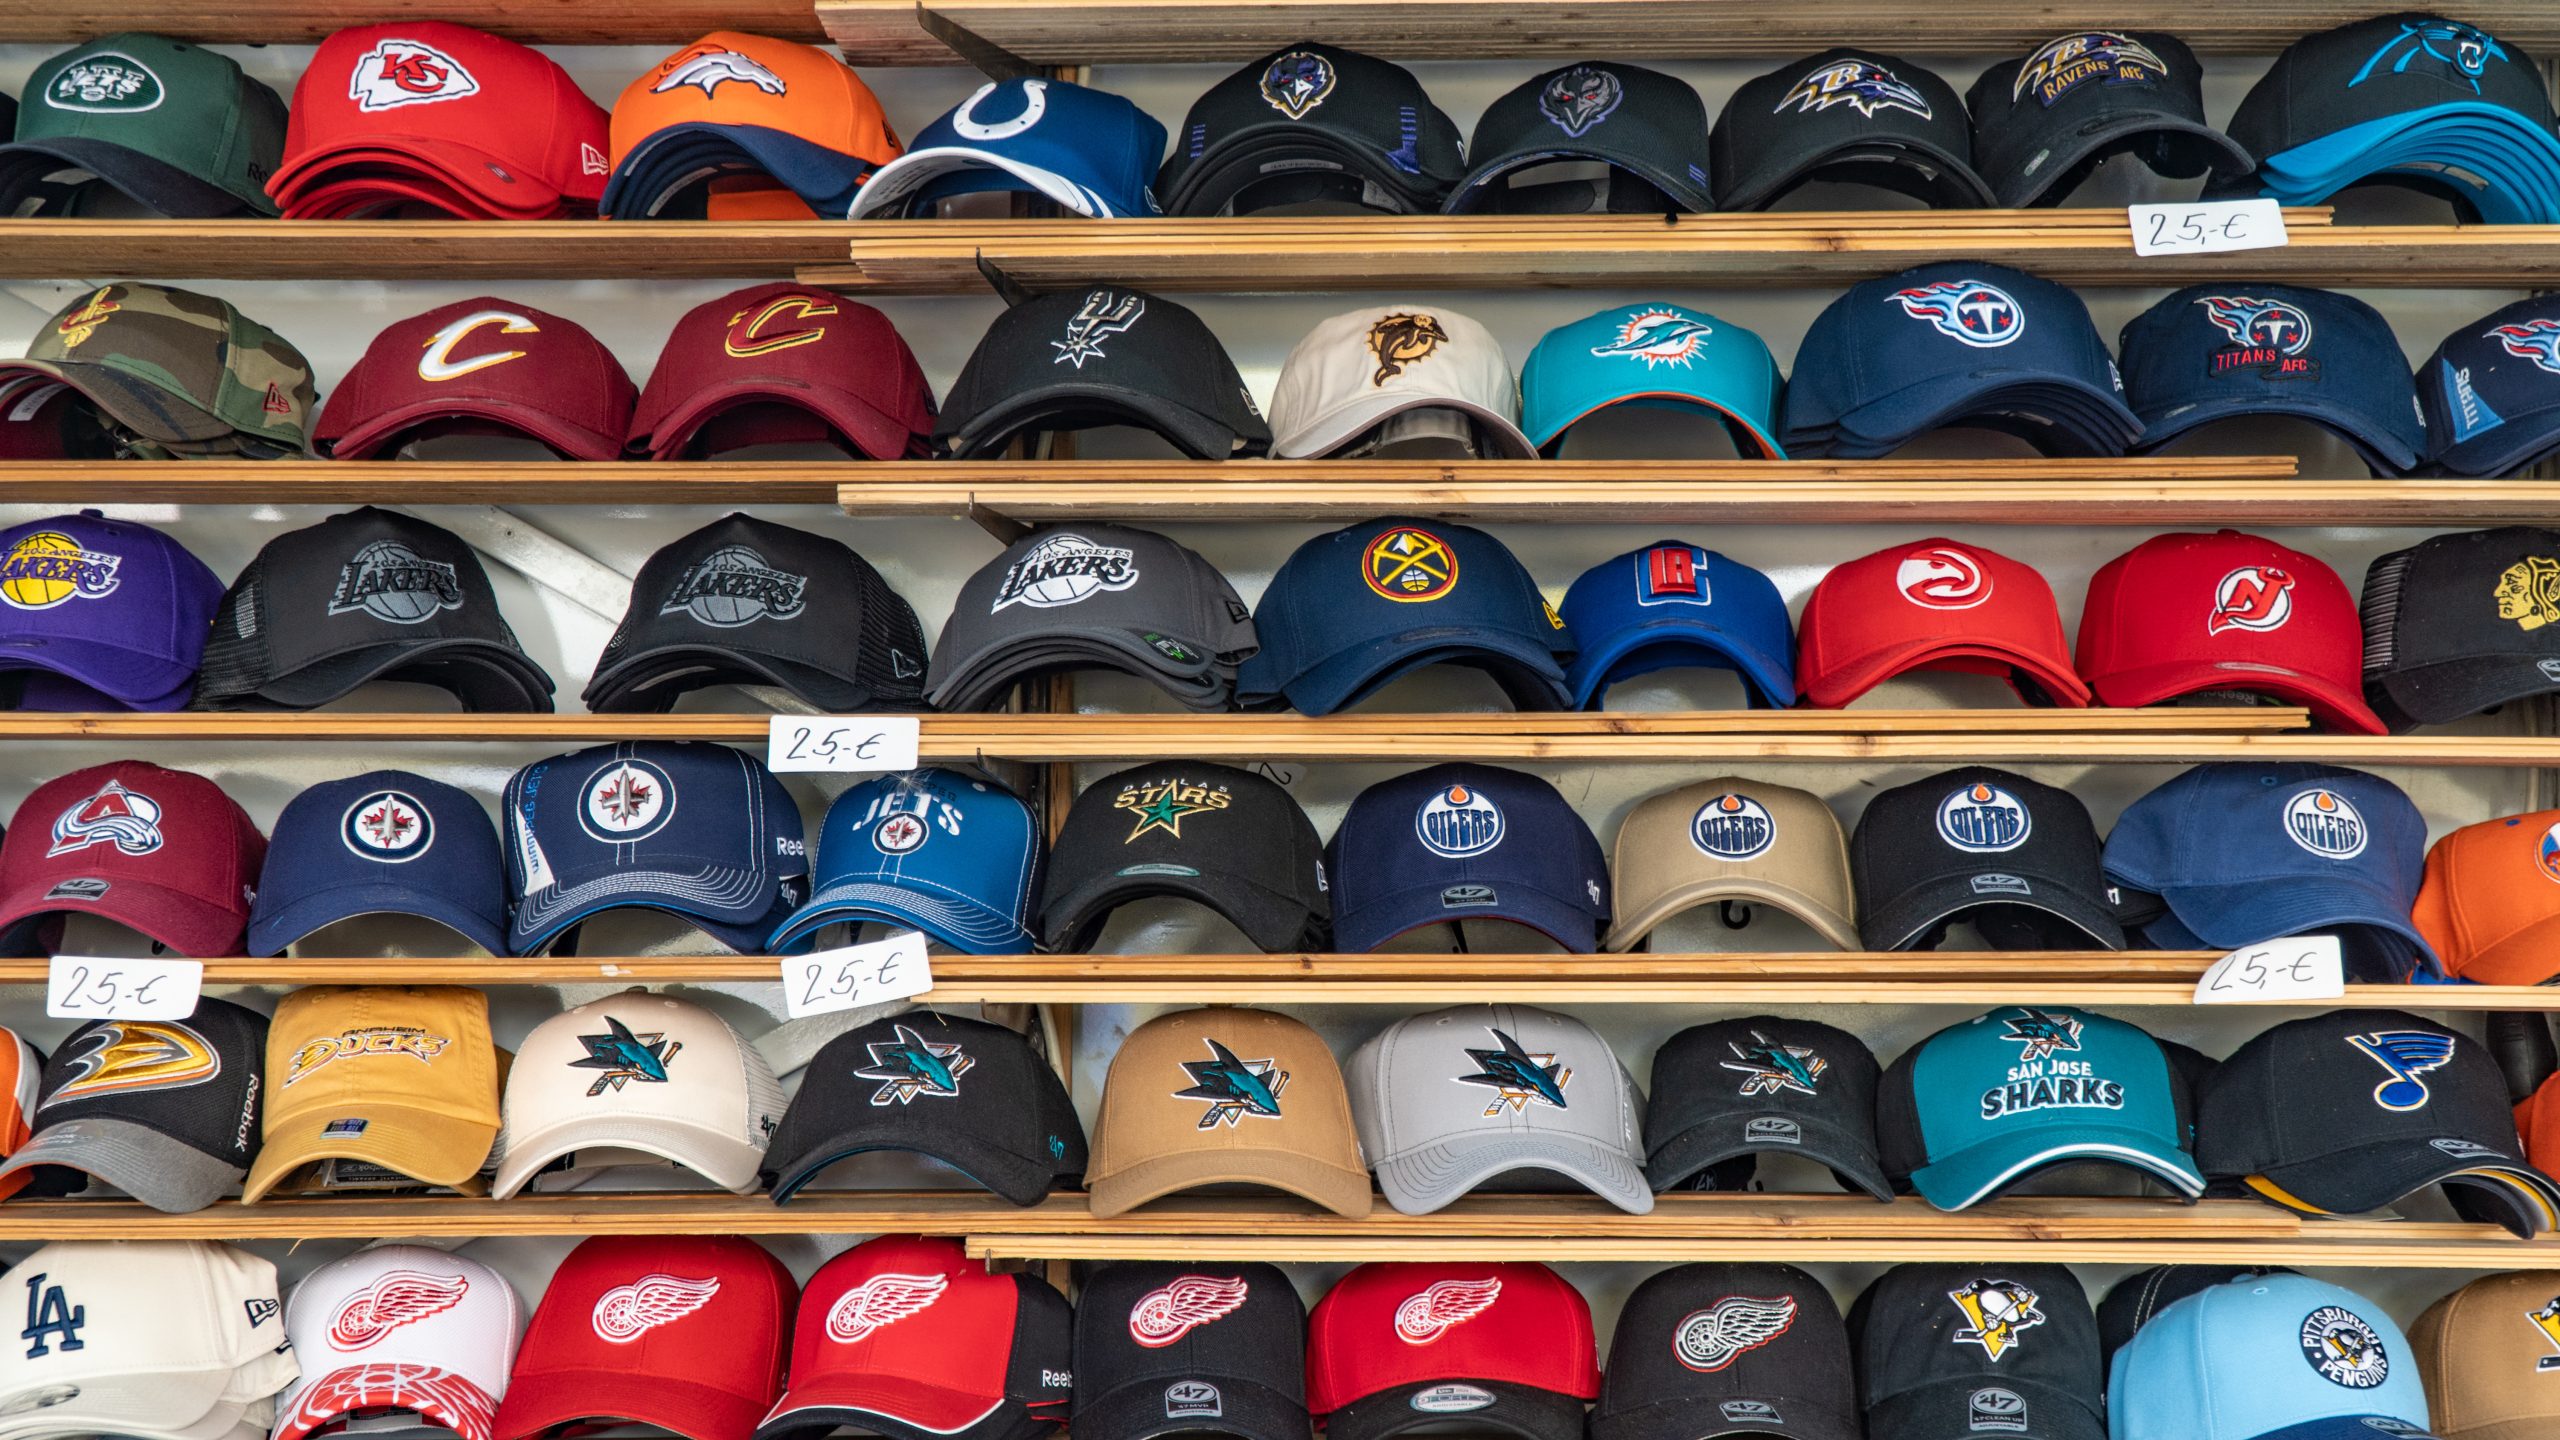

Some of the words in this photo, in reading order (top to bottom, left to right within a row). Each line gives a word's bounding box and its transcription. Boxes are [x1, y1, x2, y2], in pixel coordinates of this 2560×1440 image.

[2043, 61, 2110, 98] RAVENS
[2119, 65, 2145, 80] AFC
[2216, 349, 2276, 371] TITANS
[2281, 358, 2307, 372] AFC
[23, 547, 48, 556] LOS
[52, 548, 116, 564] ANGELES
[1038, 550, 1060, 562] LOS
[1060, 548, 1131, 558] ANGELES
[334, 561, 460, 610] LAKERS
[664, 563, 806, 614] LAKERS
[995, 556, 1136, 606] LAKERS
[1113, 779, 1233, 809] STARS
[1123, 778, 1228, 793] DALLAS
[852, 792, 963, 836] JETS
[1426, 808, 1495, 849] OILERS
[1950, 806, 2020, 844] OILERS
[2295, 811, 2358, 855] OILERS
[776, 837, 804, 856] Ree
[1700, 815, 1769, 853] OILERS
[342, 1026, 426, 1038] ANAHEIM
[282, 1035, 452, 1090] DUCKS
[2006, 1060, 2044, 1082] SAN
[2048, 1059, 2094, 1077] JOSE
[1981, 1076, 2125, 1121] SHARKS
[22, 1272, 85, 1360] LA
[2302, 1307, 2381, 1348] PITTSBURGH
[2318, 1355, 2388, 1388] PENGUINS
